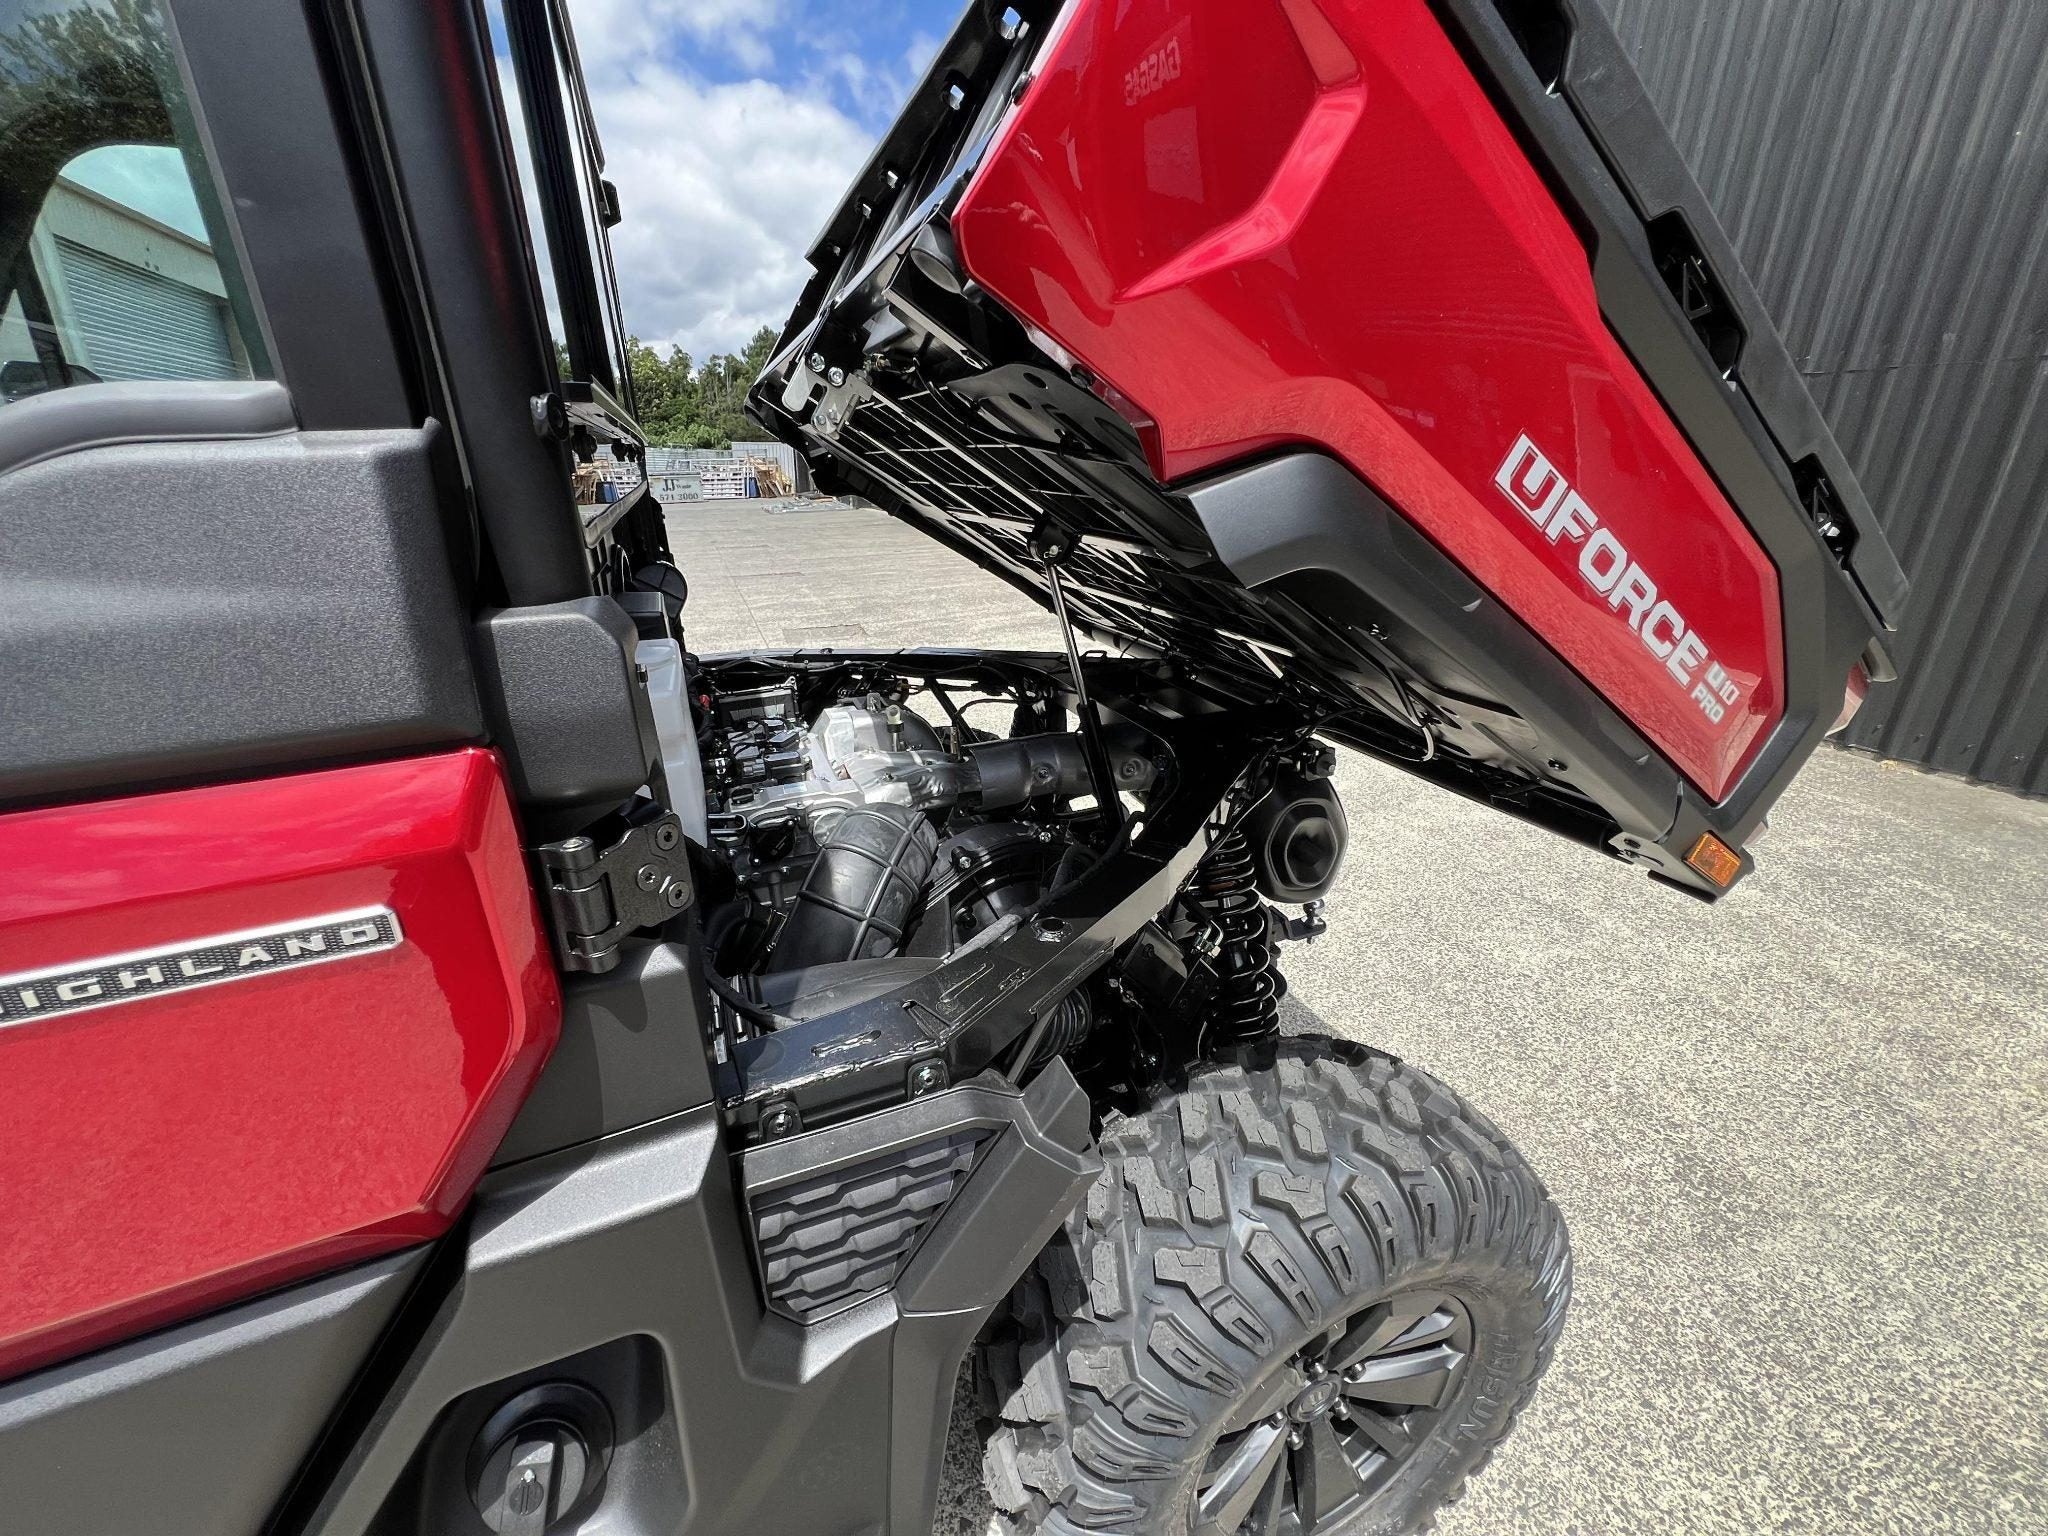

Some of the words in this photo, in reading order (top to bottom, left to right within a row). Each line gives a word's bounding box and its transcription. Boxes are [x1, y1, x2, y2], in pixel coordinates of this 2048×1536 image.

[678, 493, 699, 501] 3000
[1493, 430, 1709, 688] UFORCE
[1690, 681, 1725, 725] PRO
[0, 924, 379, 1013] IGHLAND
